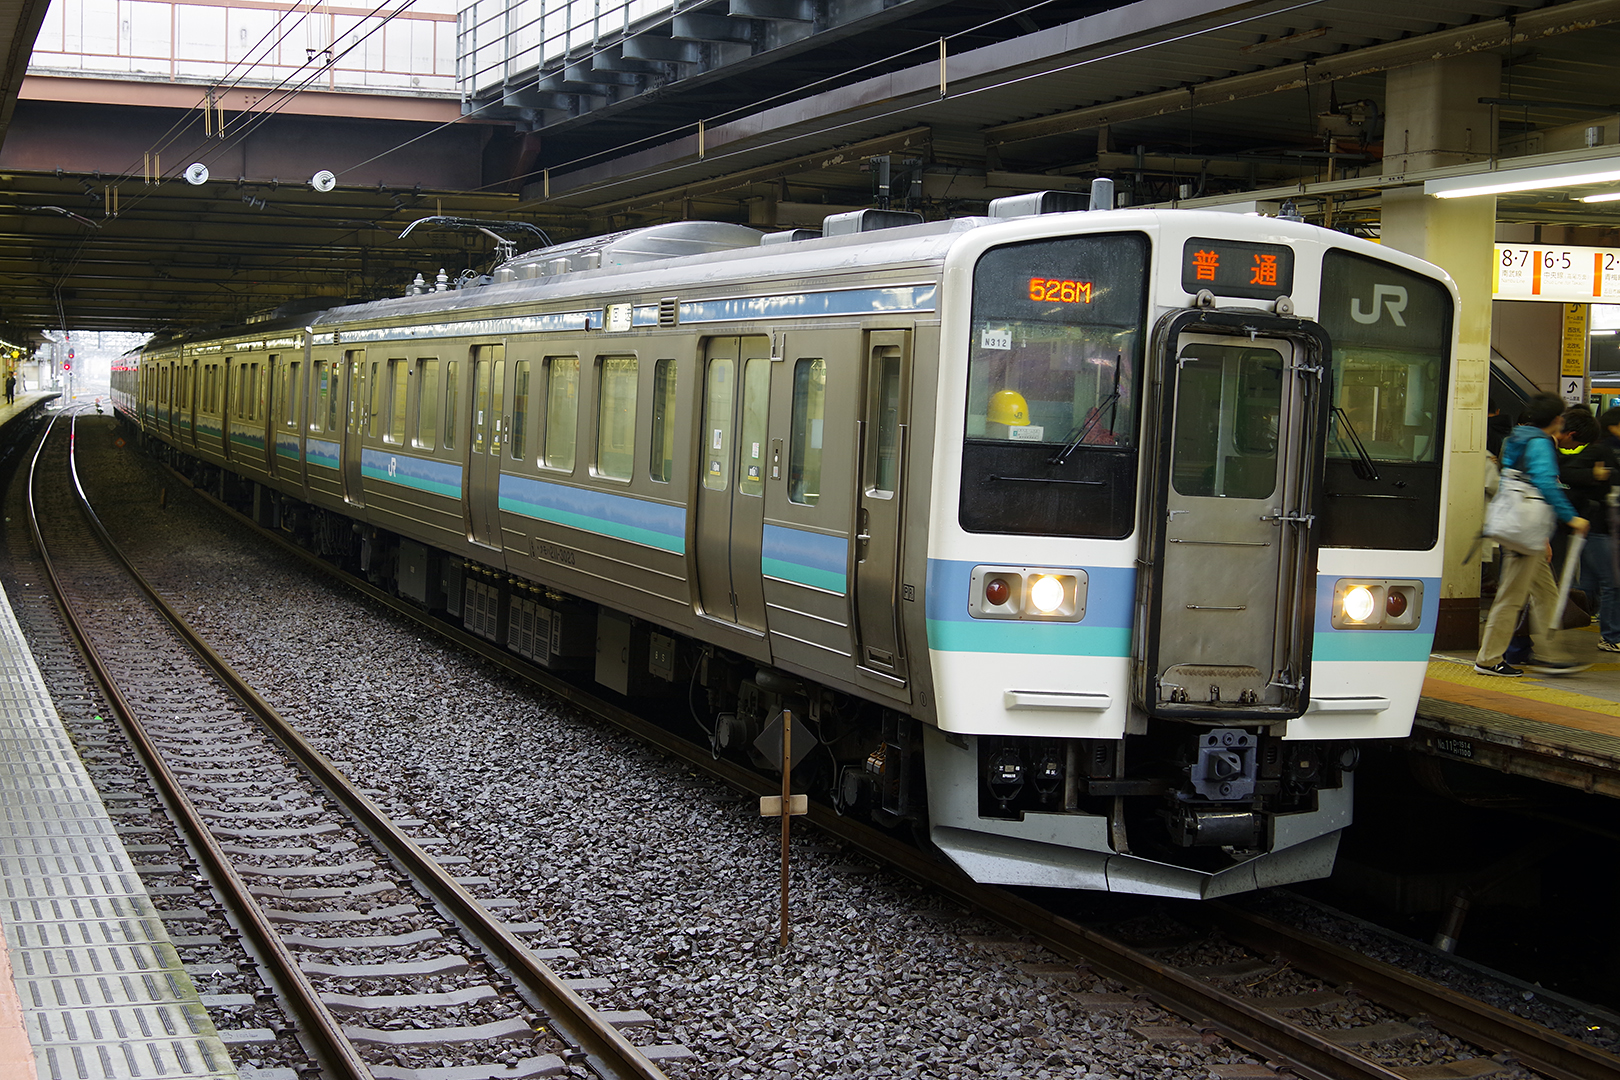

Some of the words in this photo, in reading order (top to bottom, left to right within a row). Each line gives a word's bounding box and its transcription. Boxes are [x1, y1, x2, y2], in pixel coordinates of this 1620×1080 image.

[1192, 249, 1277, 286] 普通
[1029, 277, 1092, 304] 526M
[1351, 283, 1408, 327] JR
[984, 338, 1007, 347] N312
[388, 457, 397, 477] JR
